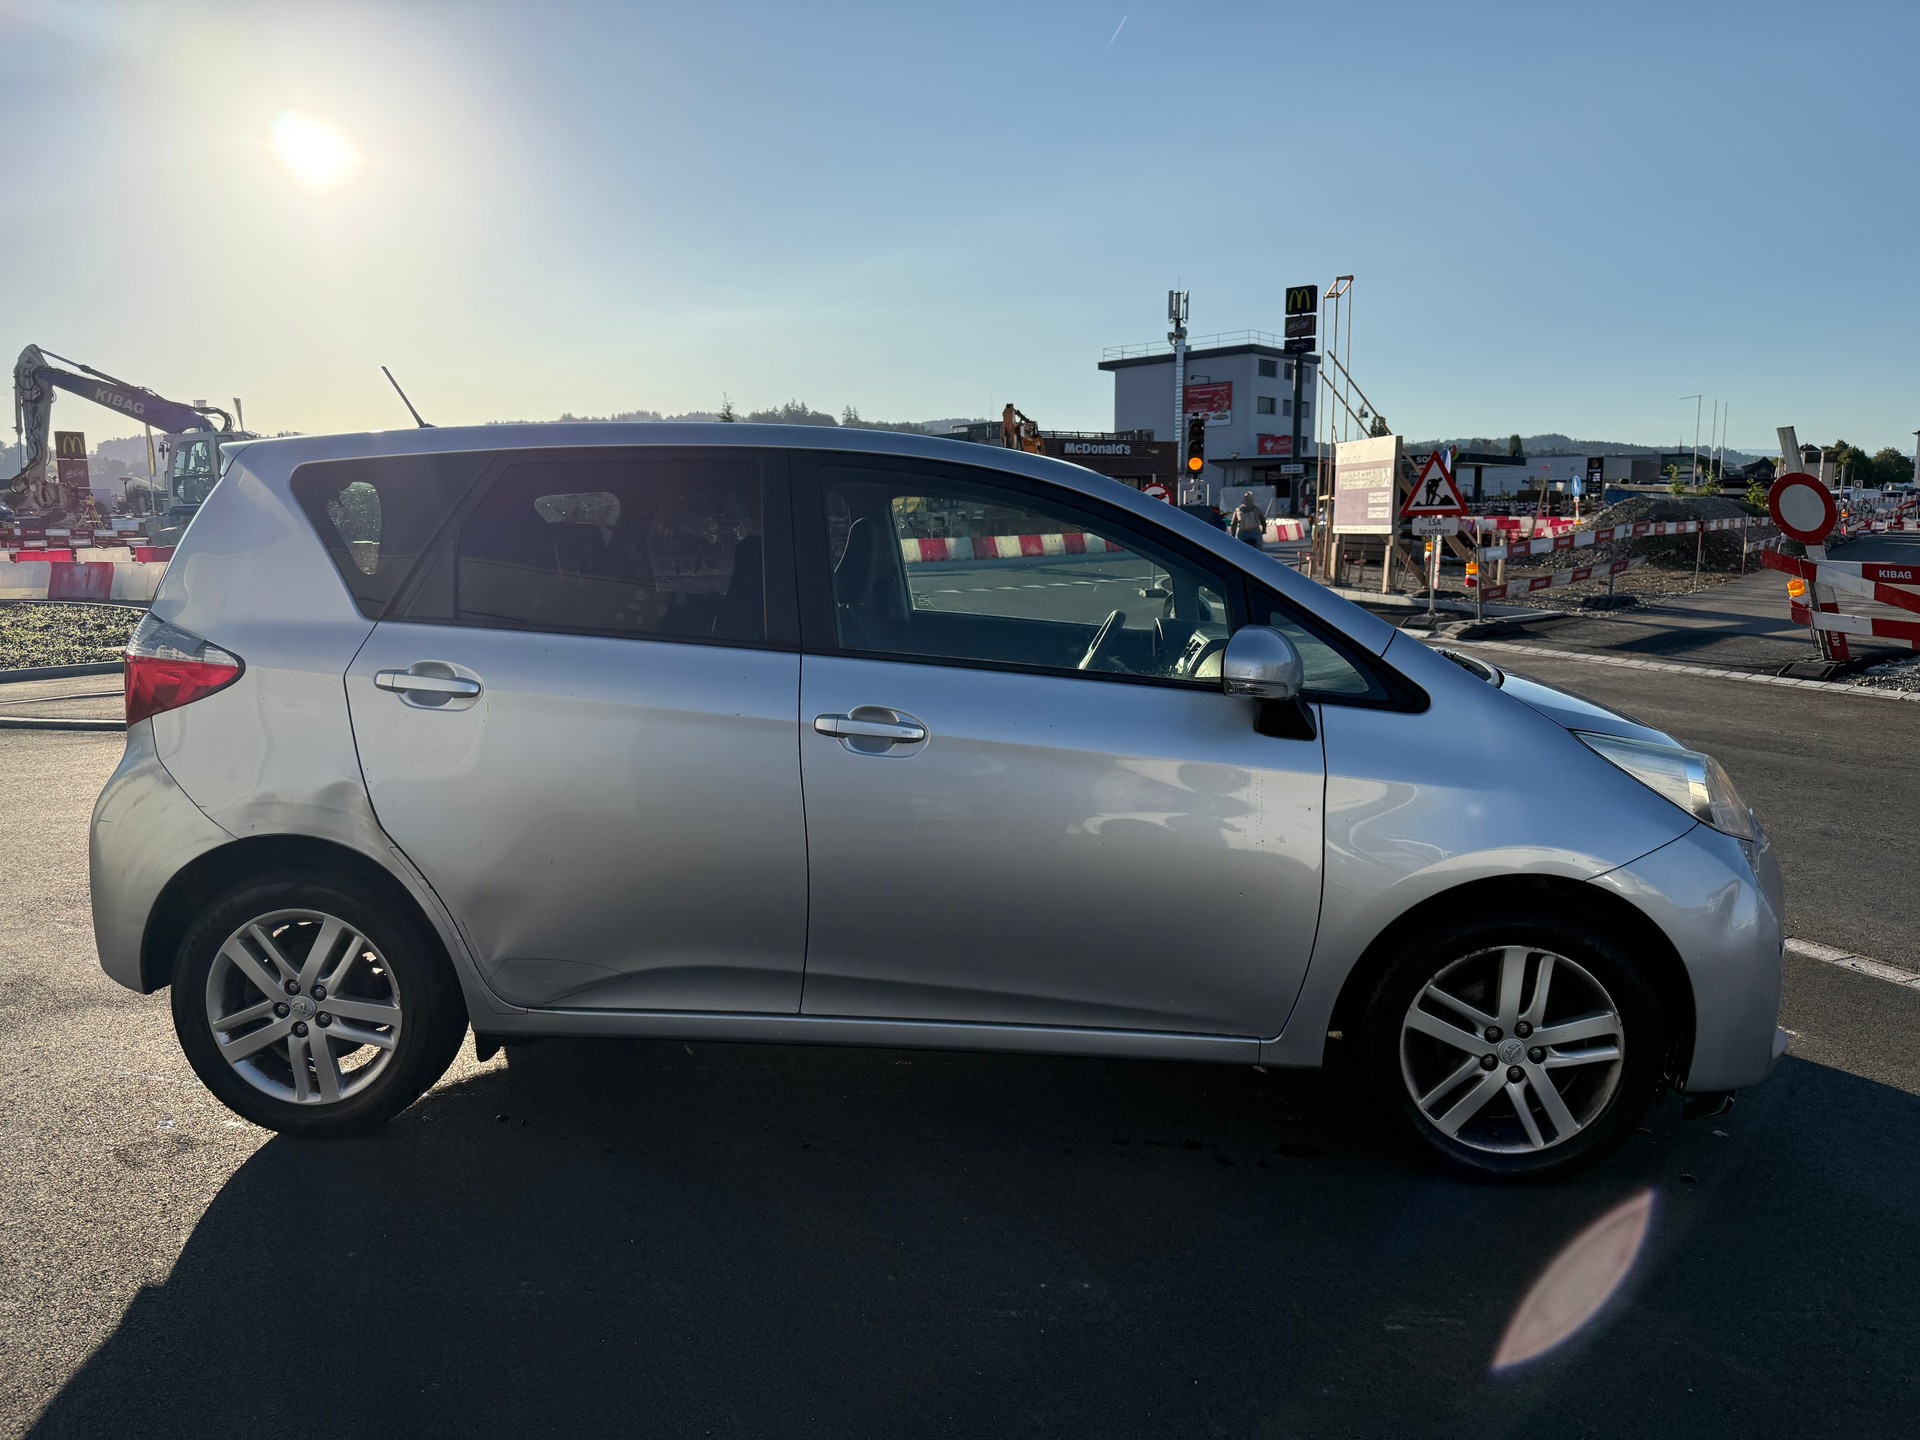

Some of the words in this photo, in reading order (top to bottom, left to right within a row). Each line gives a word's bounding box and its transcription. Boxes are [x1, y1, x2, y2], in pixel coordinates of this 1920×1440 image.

[95, 388, 145, 415] KIBAG
[1064, 442, 1131, 455] McDonald's
[1878, 569, 1913, 579] KIBAG
